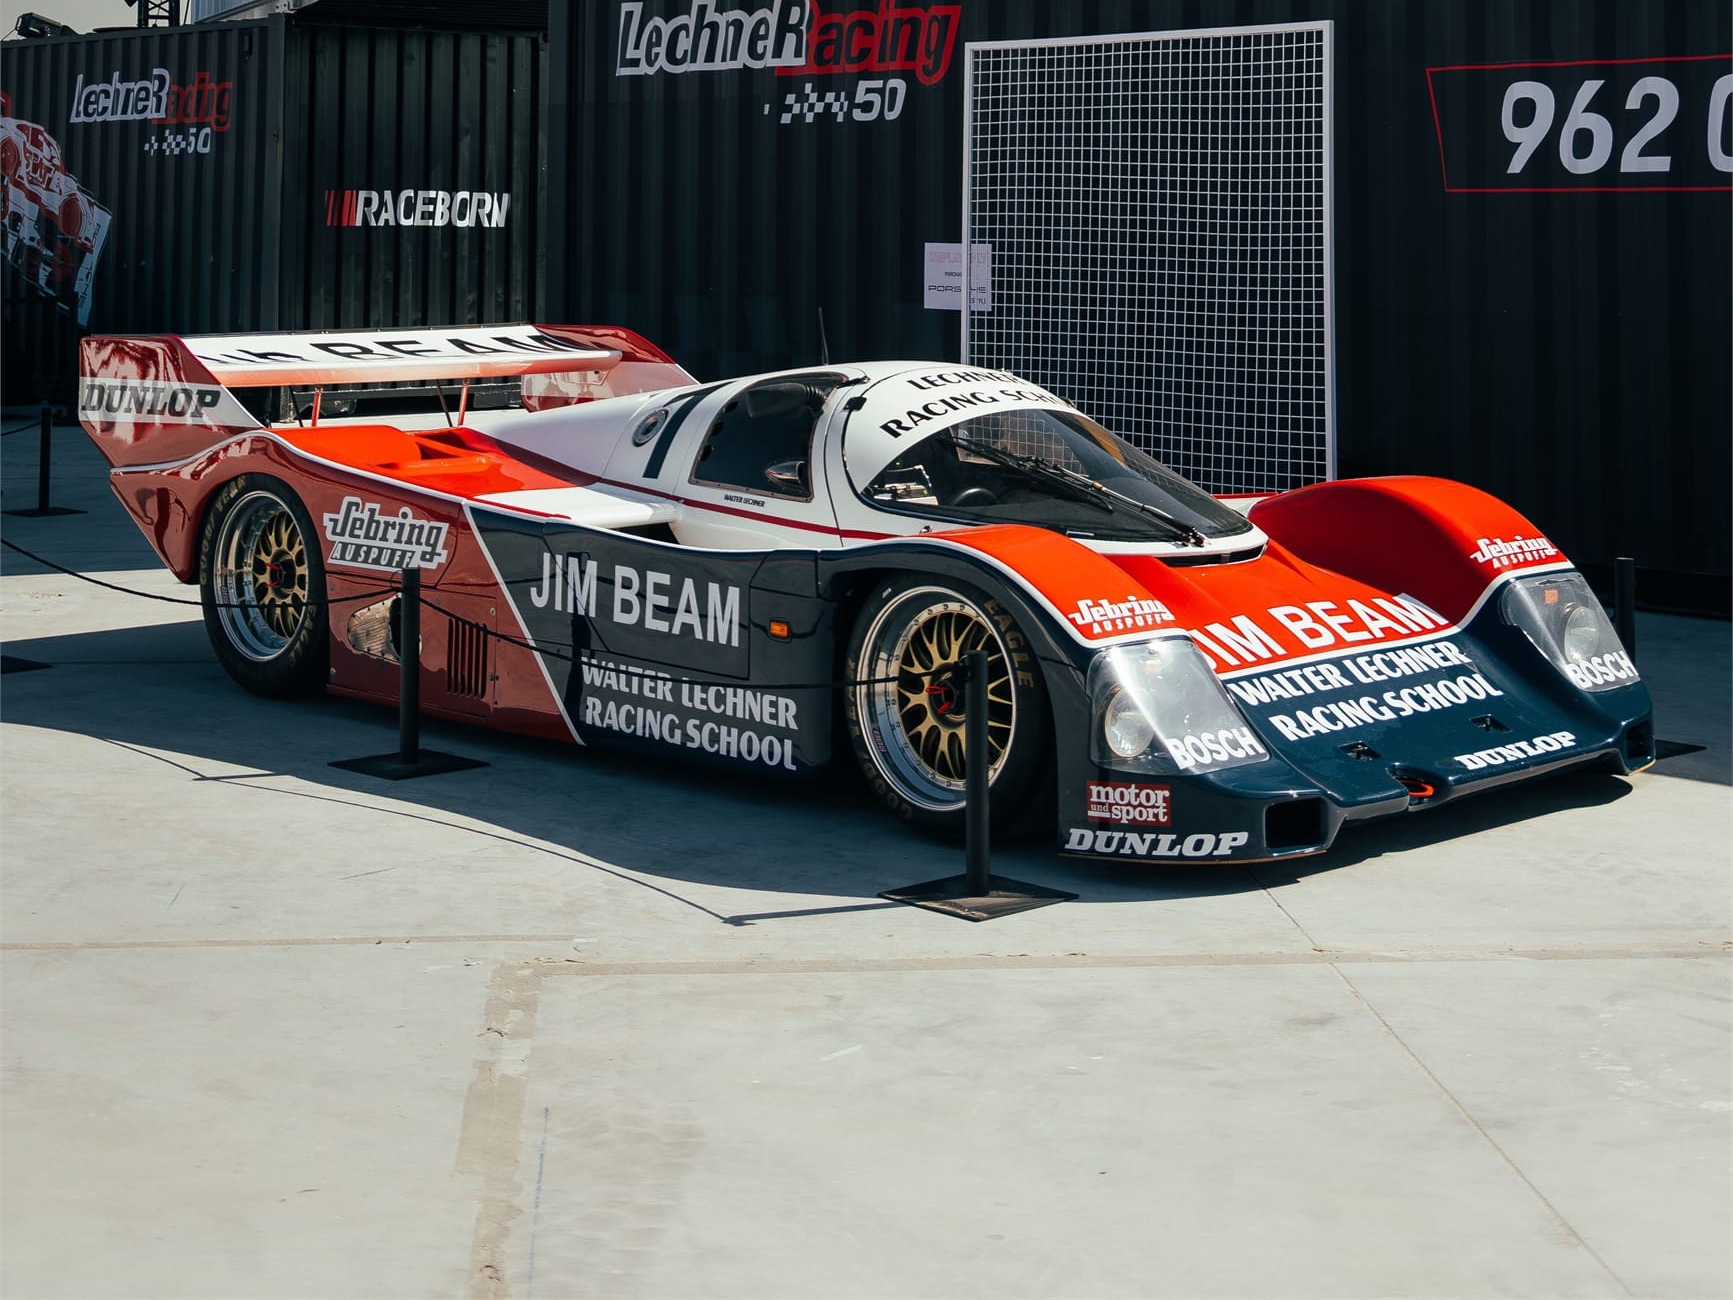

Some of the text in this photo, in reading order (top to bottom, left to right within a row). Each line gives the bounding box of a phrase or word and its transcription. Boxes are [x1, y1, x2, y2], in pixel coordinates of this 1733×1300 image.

[852, 79, 907, 121] 50
[187, 127, 211, 154] 50
[1501, 76, 1680, 175] 962
[356, 189, 509, 227] RACEBORN
[81, 383, 221, 418] DUNLOP
[879, 391, 1000, 438] RACING
[327, 499, 444, 564] Sebring
[331, 542, 414, 568] AUSPUFF
[530, 552, 740, 647] JIM BEAM
[1068, 596, 1176, 627] Sebring
[1092, 614, 1163, 634] AUSPUFF
[1267, 594, 1451, 650] BEAM
[984, 599, 1035, 689] EAGLE
[1227, 641, 1473, 706] WALTER LECHNER
[1565, 650, 1640, 689] BOSCH
[581, 657, 799, 730] WALTER LECHNER
[1268, 672, 1505, 742] RACING SCHOOL
[585, 696, 797, 771] RACING SCHOOL
[1166, 726, 1267, 770] BOSCH
[1453, 731, 1577, 770] DUNLOP
[1090, 783, 1170, 806] motor
[1090, 802, 1168, 823] und sport
[1065, 828, 1248, 856] DUNLOP
